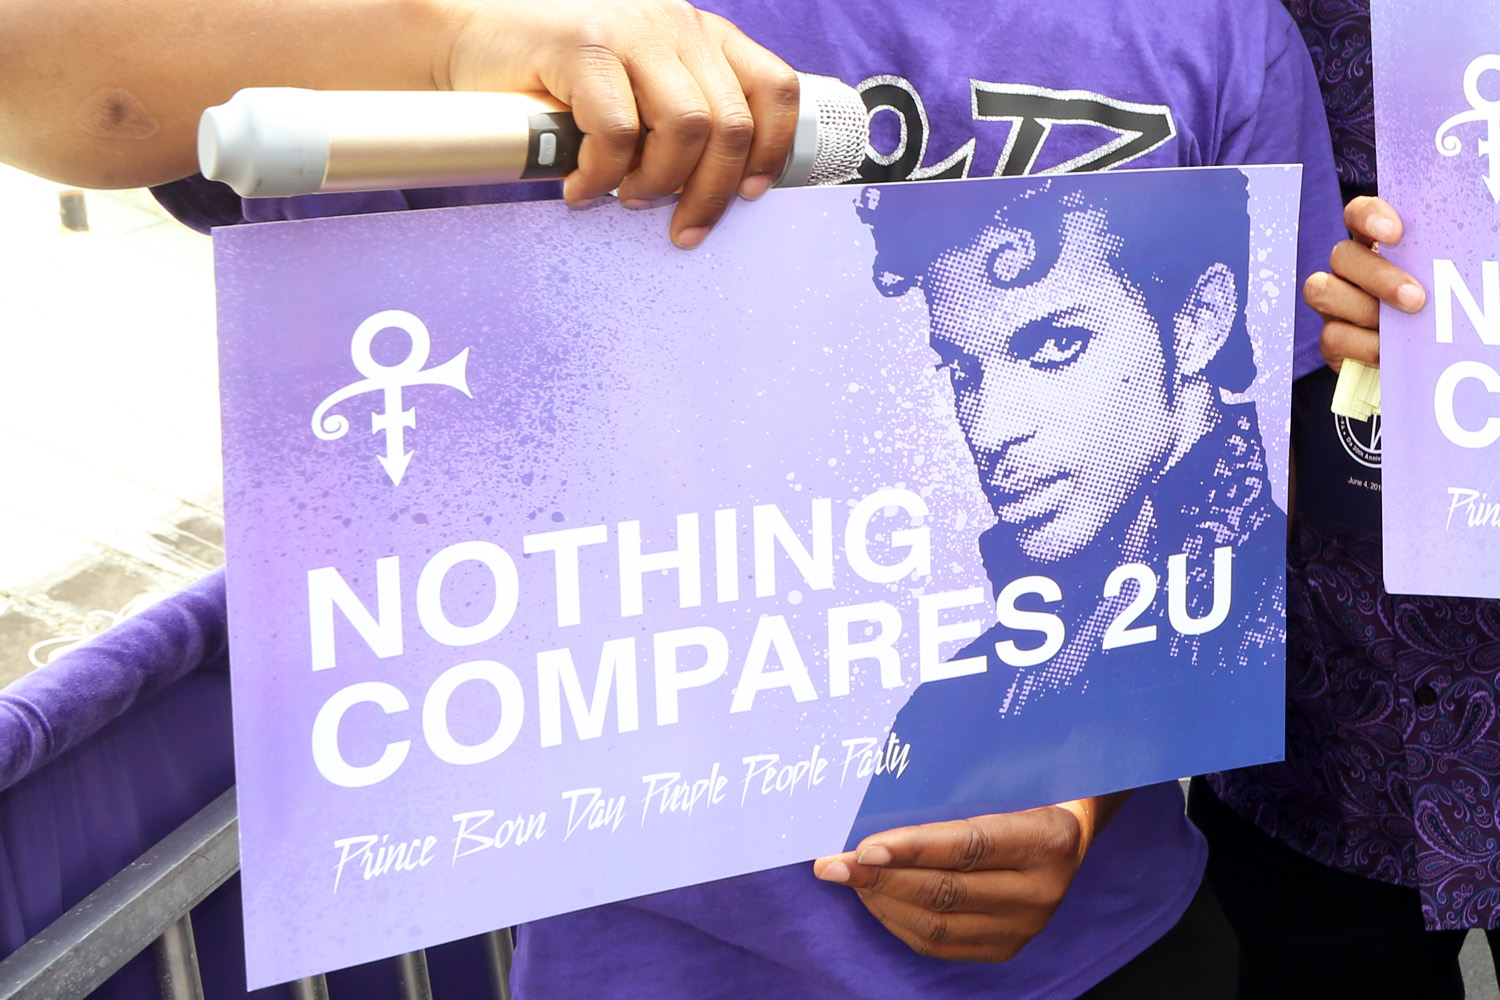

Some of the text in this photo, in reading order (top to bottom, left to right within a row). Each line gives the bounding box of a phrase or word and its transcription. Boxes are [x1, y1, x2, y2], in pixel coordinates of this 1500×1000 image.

[1347, 476, 1363, 487] June
[1370, 481, 1382, 492] 201
[307, 487, 933, 672] NOTHING
[311, 546, 1233, 789] COMPARES 2U
[331, 731, 911, 895] Prince Born Day Purple People Party
